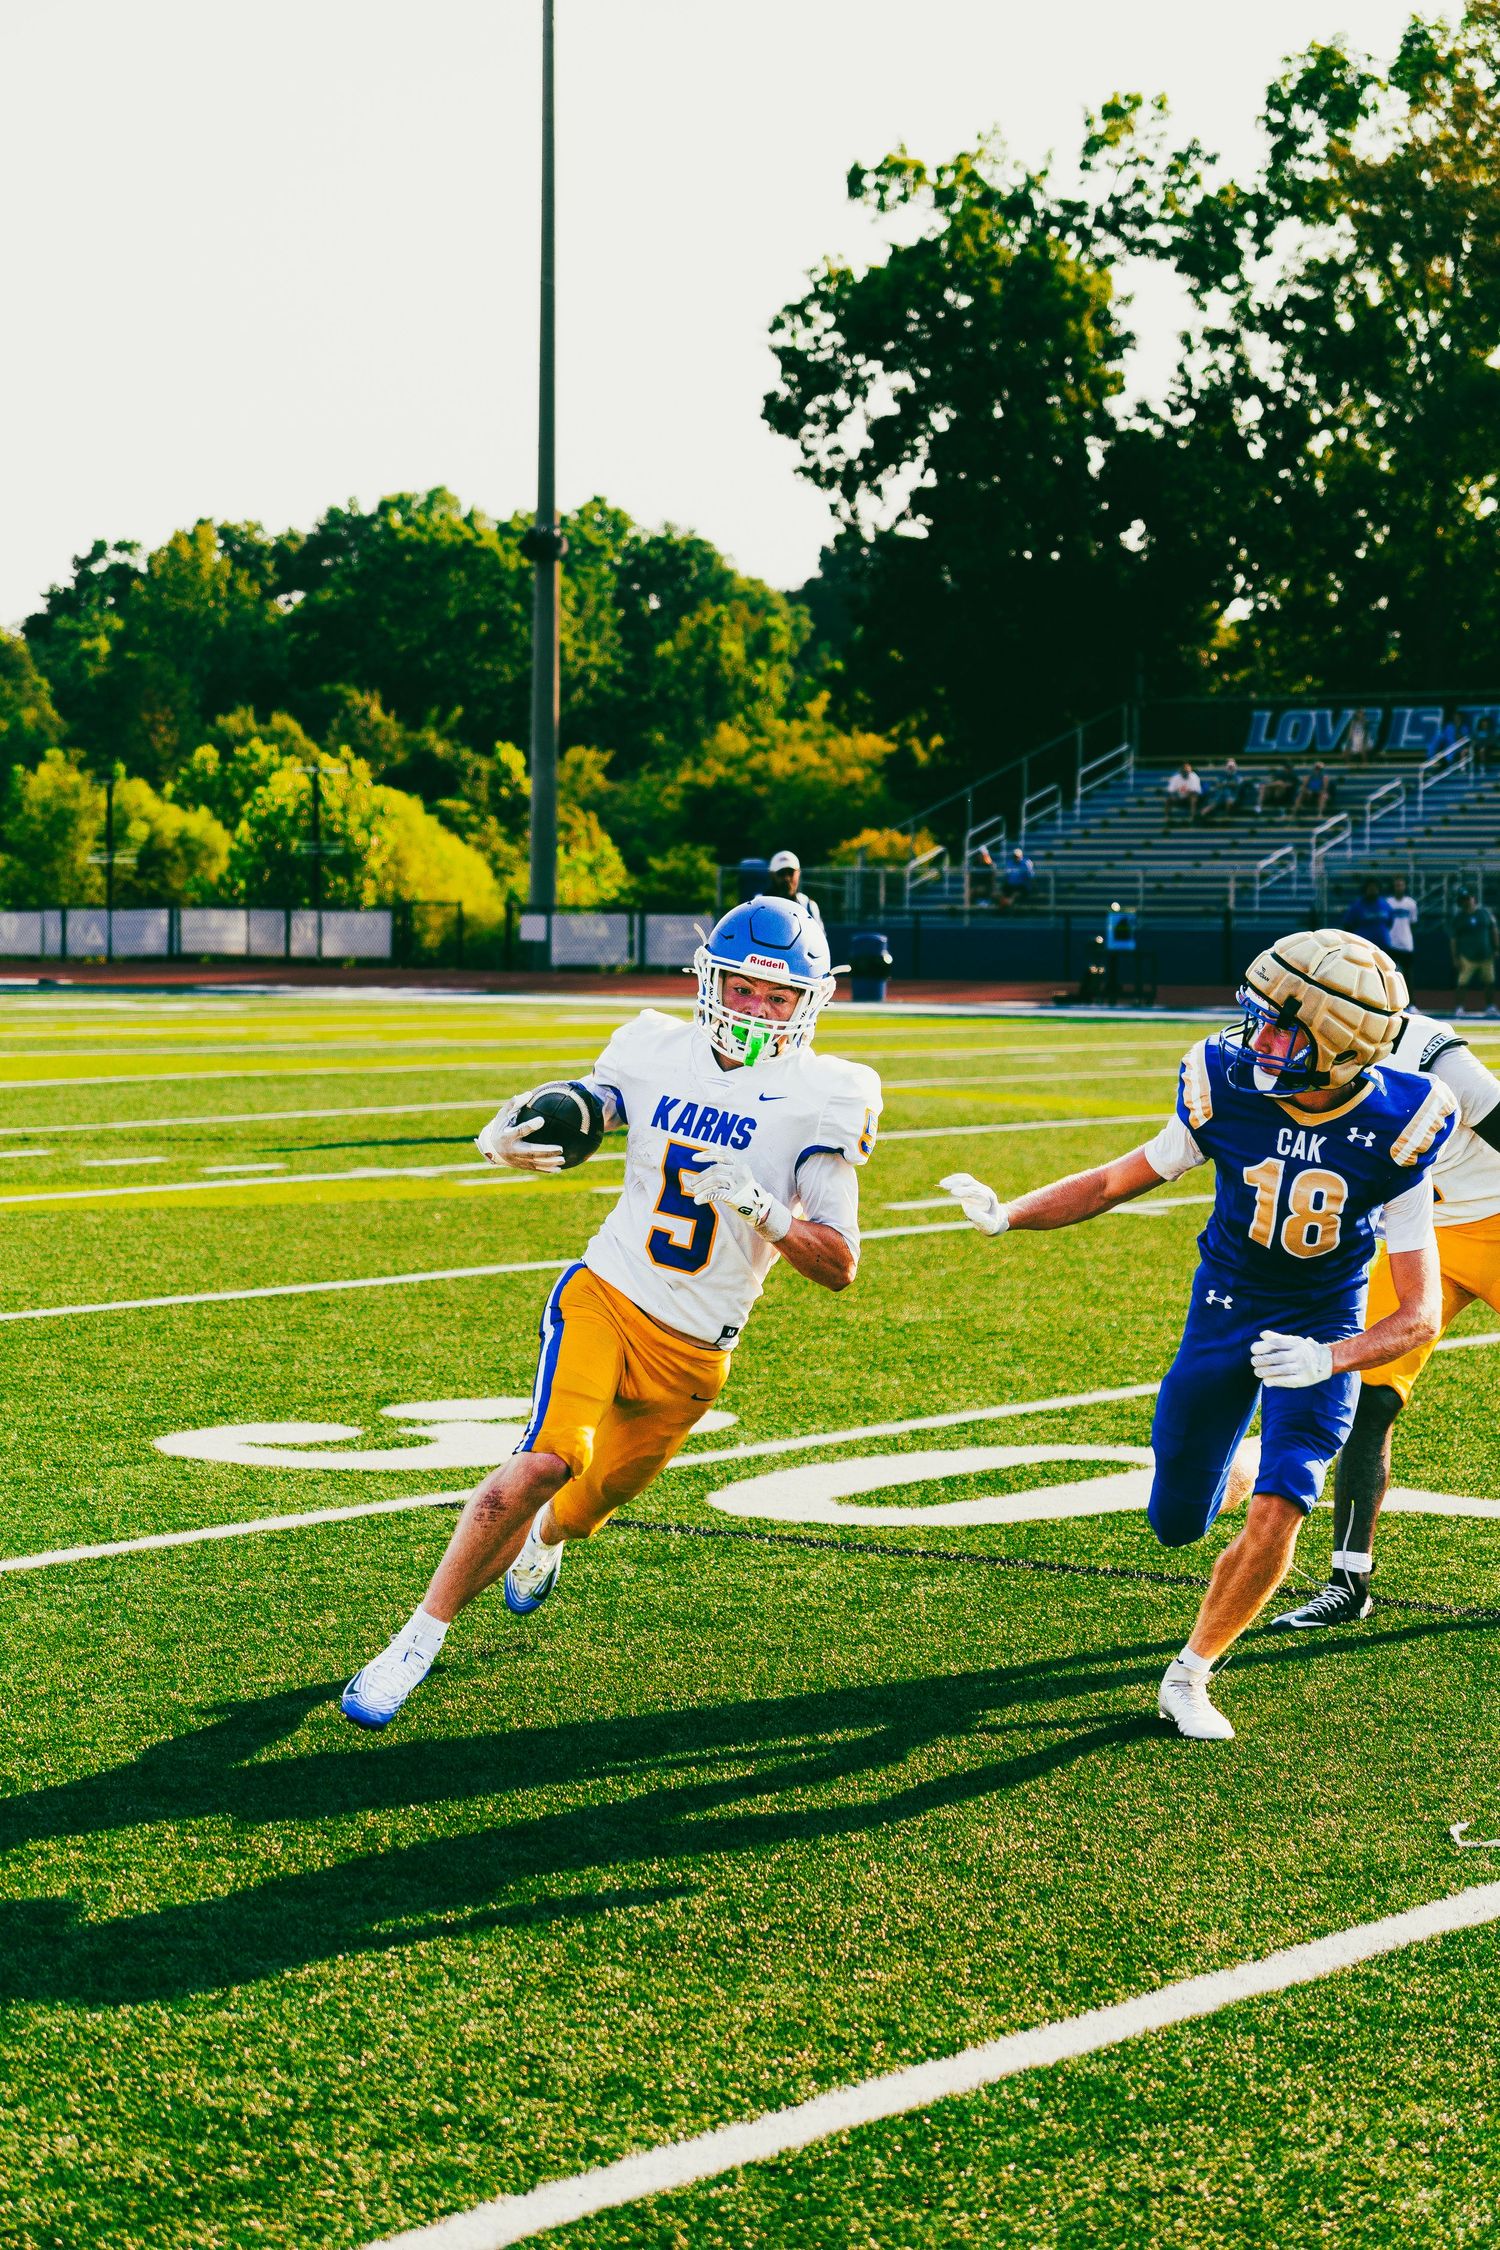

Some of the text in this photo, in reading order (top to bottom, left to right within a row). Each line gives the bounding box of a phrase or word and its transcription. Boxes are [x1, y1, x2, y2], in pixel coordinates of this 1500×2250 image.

[1383, 707, 1443, 750] IS
[750, 956, 785, 970] Riddell
[651, 1095, 757, 1150] KARNS
[1276, 1127, 1328, 1164] CAK
[645, 1138, 719, 1276] 5
[1243, 1157, 1349, 1259] 18
